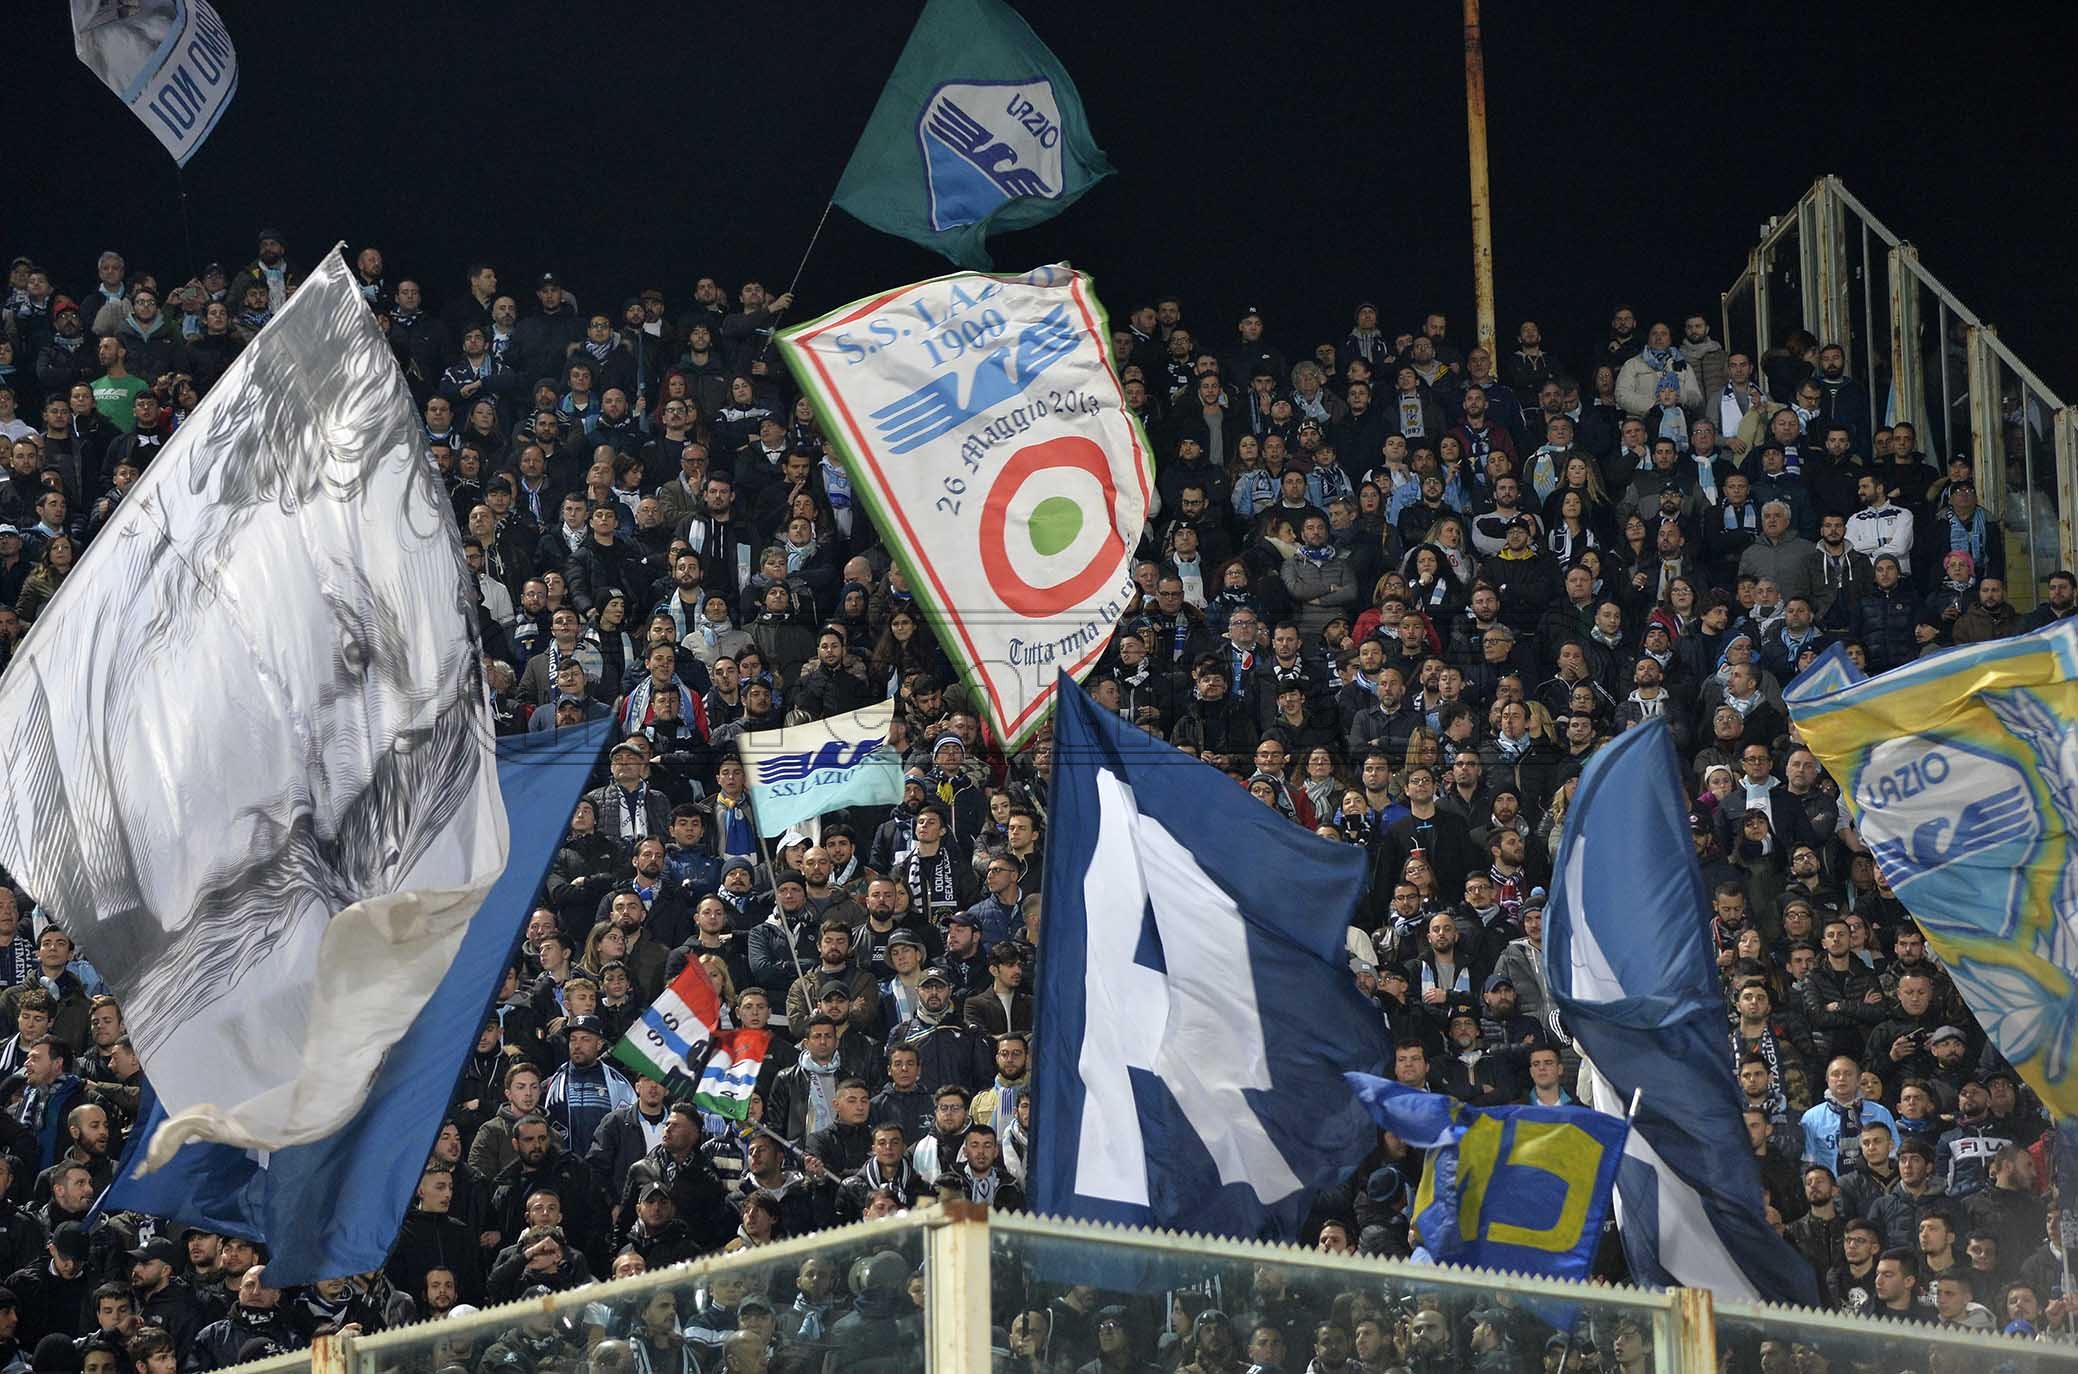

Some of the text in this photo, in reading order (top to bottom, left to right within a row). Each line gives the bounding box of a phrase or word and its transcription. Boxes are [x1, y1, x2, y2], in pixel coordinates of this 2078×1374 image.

[1006, 93, 1059, 149] LAZIO
[920, 308, 1008, 369] 1900
[936, 390, 1101, 516] 26 Maggio 2013
[1009, 638, 1056, 666] Tutta
[1059, 622, 1100, 656] mia
[1099, 601, 1121, 624] la
[1866, 752, 1950, 809] LAZIO
